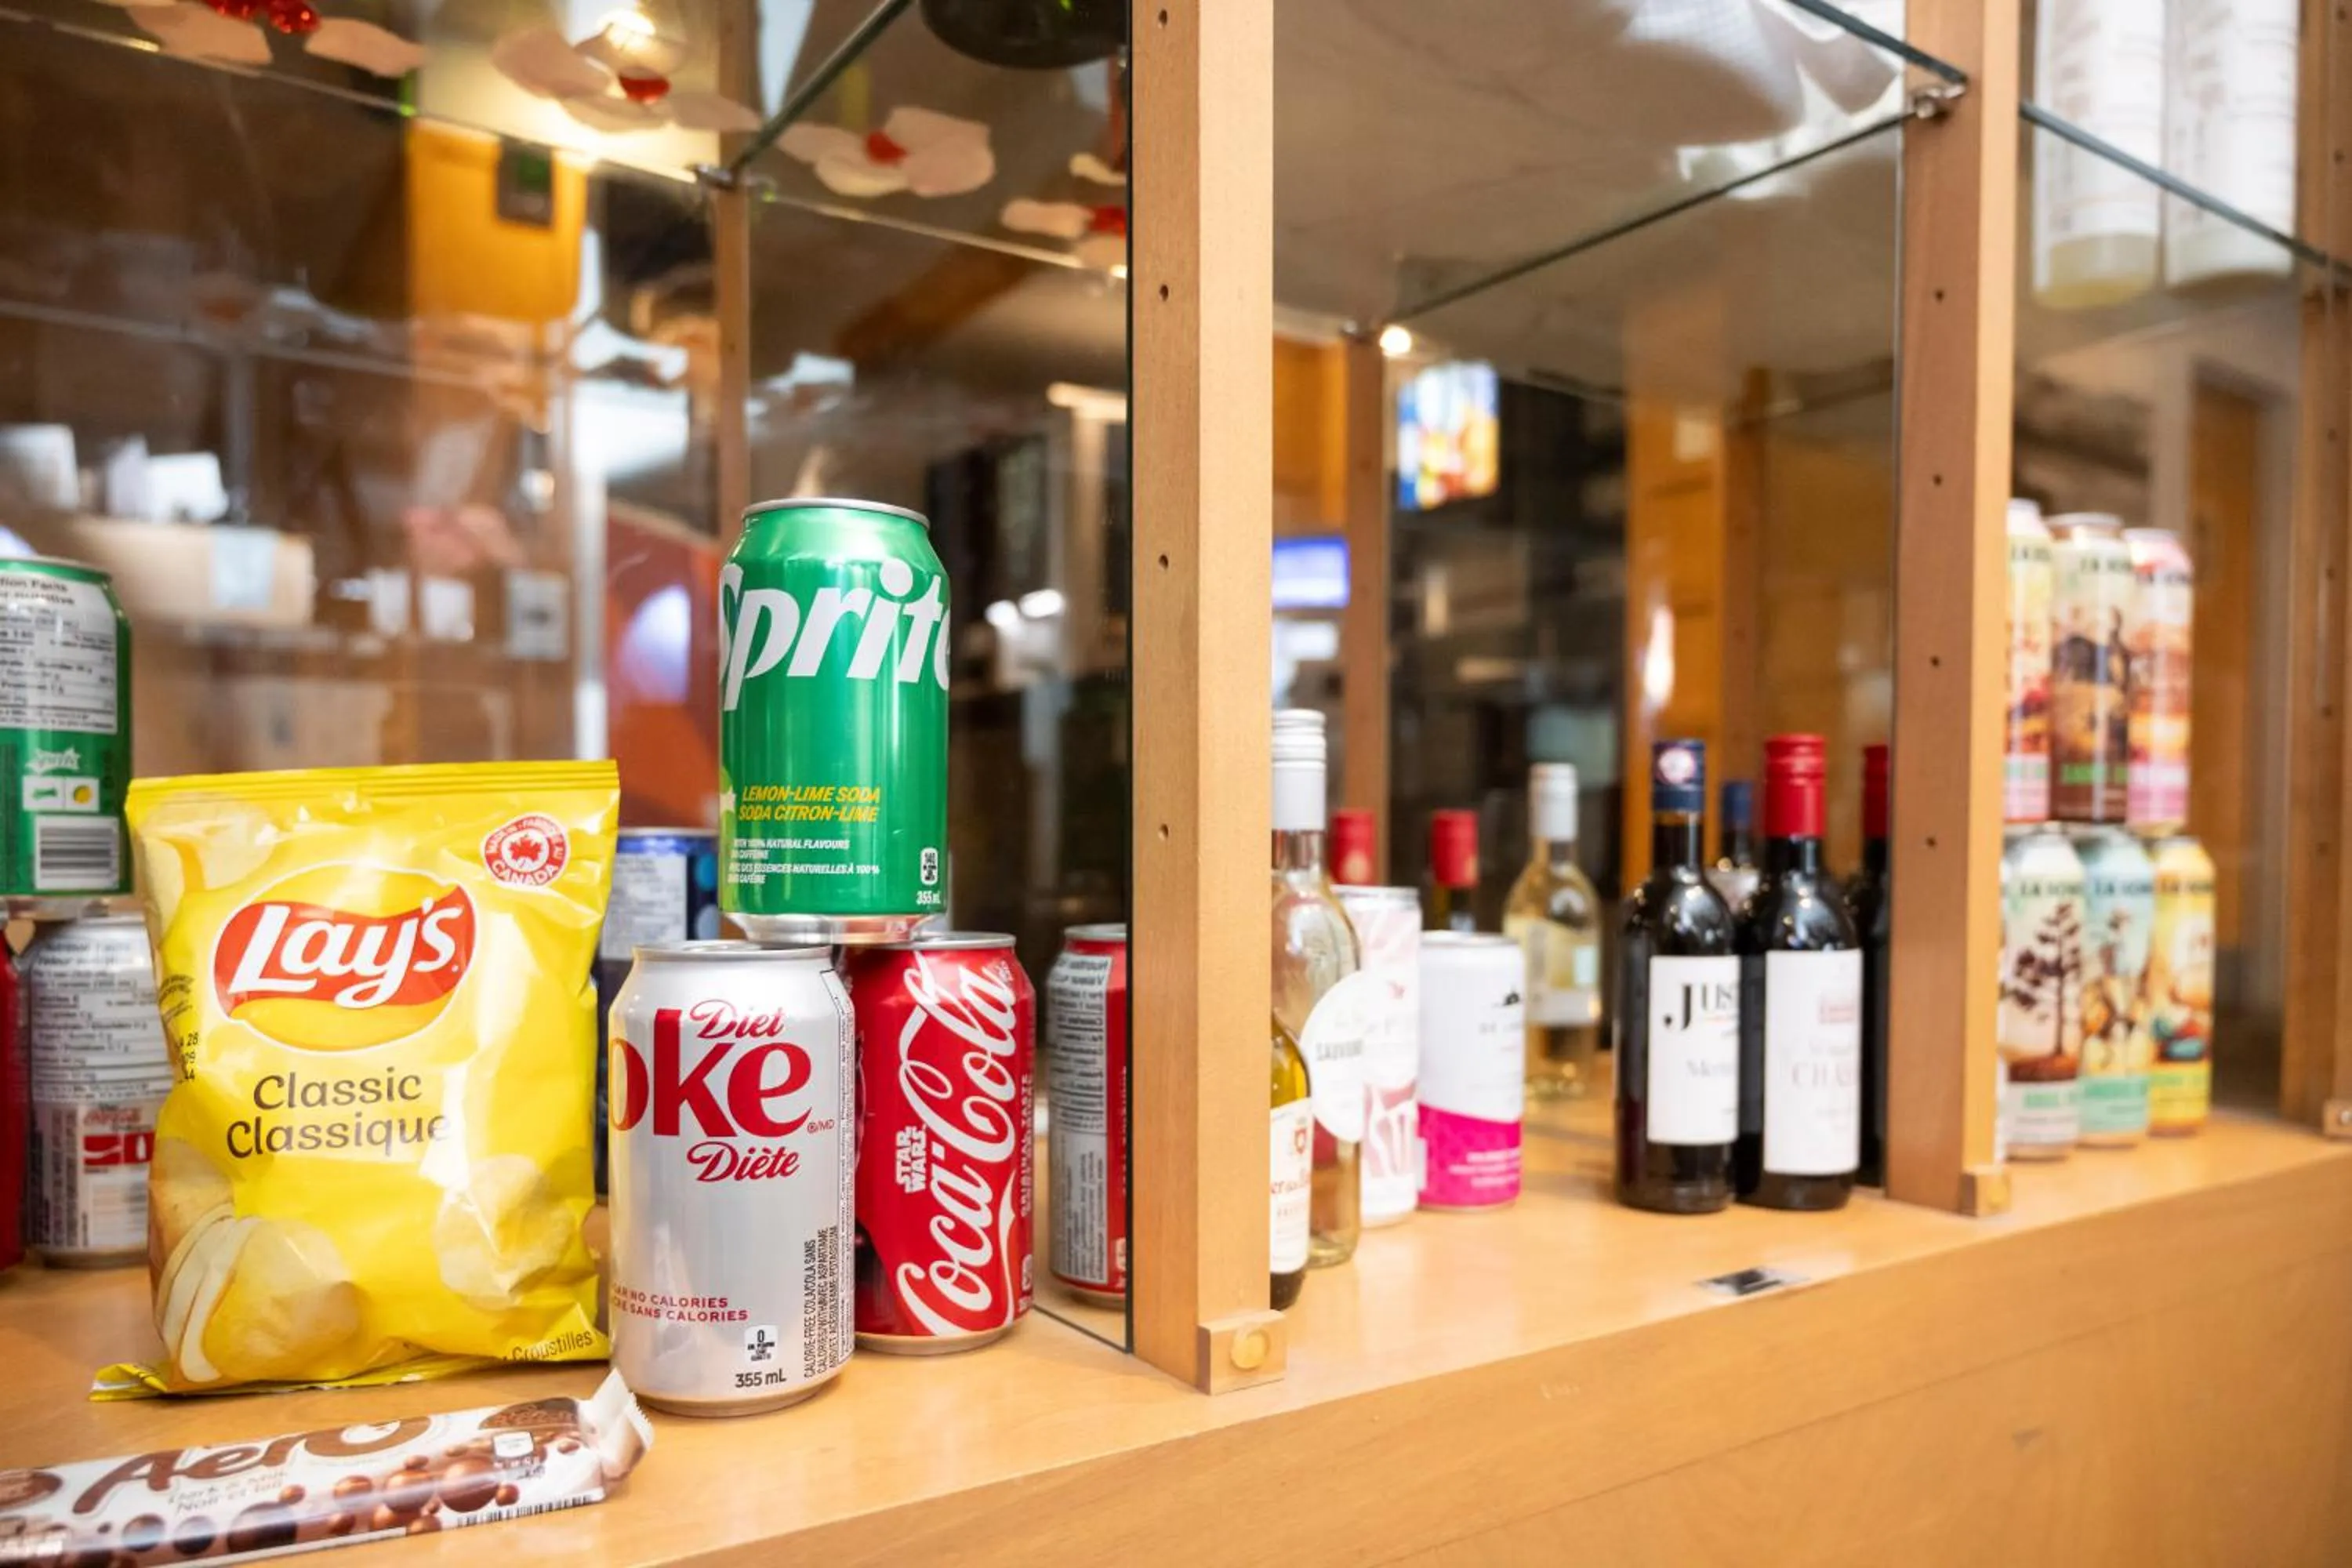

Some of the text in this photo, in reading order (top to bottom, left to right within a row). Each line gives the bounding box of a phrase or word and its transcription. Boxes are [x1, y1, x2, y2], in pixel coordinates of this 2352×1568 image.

[739, 805, 879, 822] SODA CITRON-LIME
[742, 786, 880, 804] LEMON-LIME SODA
[766, 839, 802, 849] NATURAL
[803, 839, 850, 850] FLAVOURS
[492, 859, 559, 886] CANADA
[228, 896, 463, 1008] Lay's
[689, 999, 786, 1040] Diet
[252, 1066, 423, 1110] Classic
[226, 1112, 451, 1160] Classique
[895, 1126, 912, 1185] STAR
[896, 950, 1017, 1336] Coca-Cola
[686, 1141, 801, 1184] Diète
[905, 1125, 927, 1193] WARS
[818, 1228, 828, 1280] ASPARTAME
[630, 1291, 646, 1303] NO
[650, 1294, 728, 1308] CALORIES
[630, 1305, 661, 1319] SANS
[666, 1309, 749, 1323] CALORIES
[804, 1239, 816, 1378] CALORIE-FREE COLA/COLA SANS
[512, 1330, 593, 1362] Croustilles
[757, 1329, 765, 1343] 0
[735, 1367, 788, 1388] 355 mL
